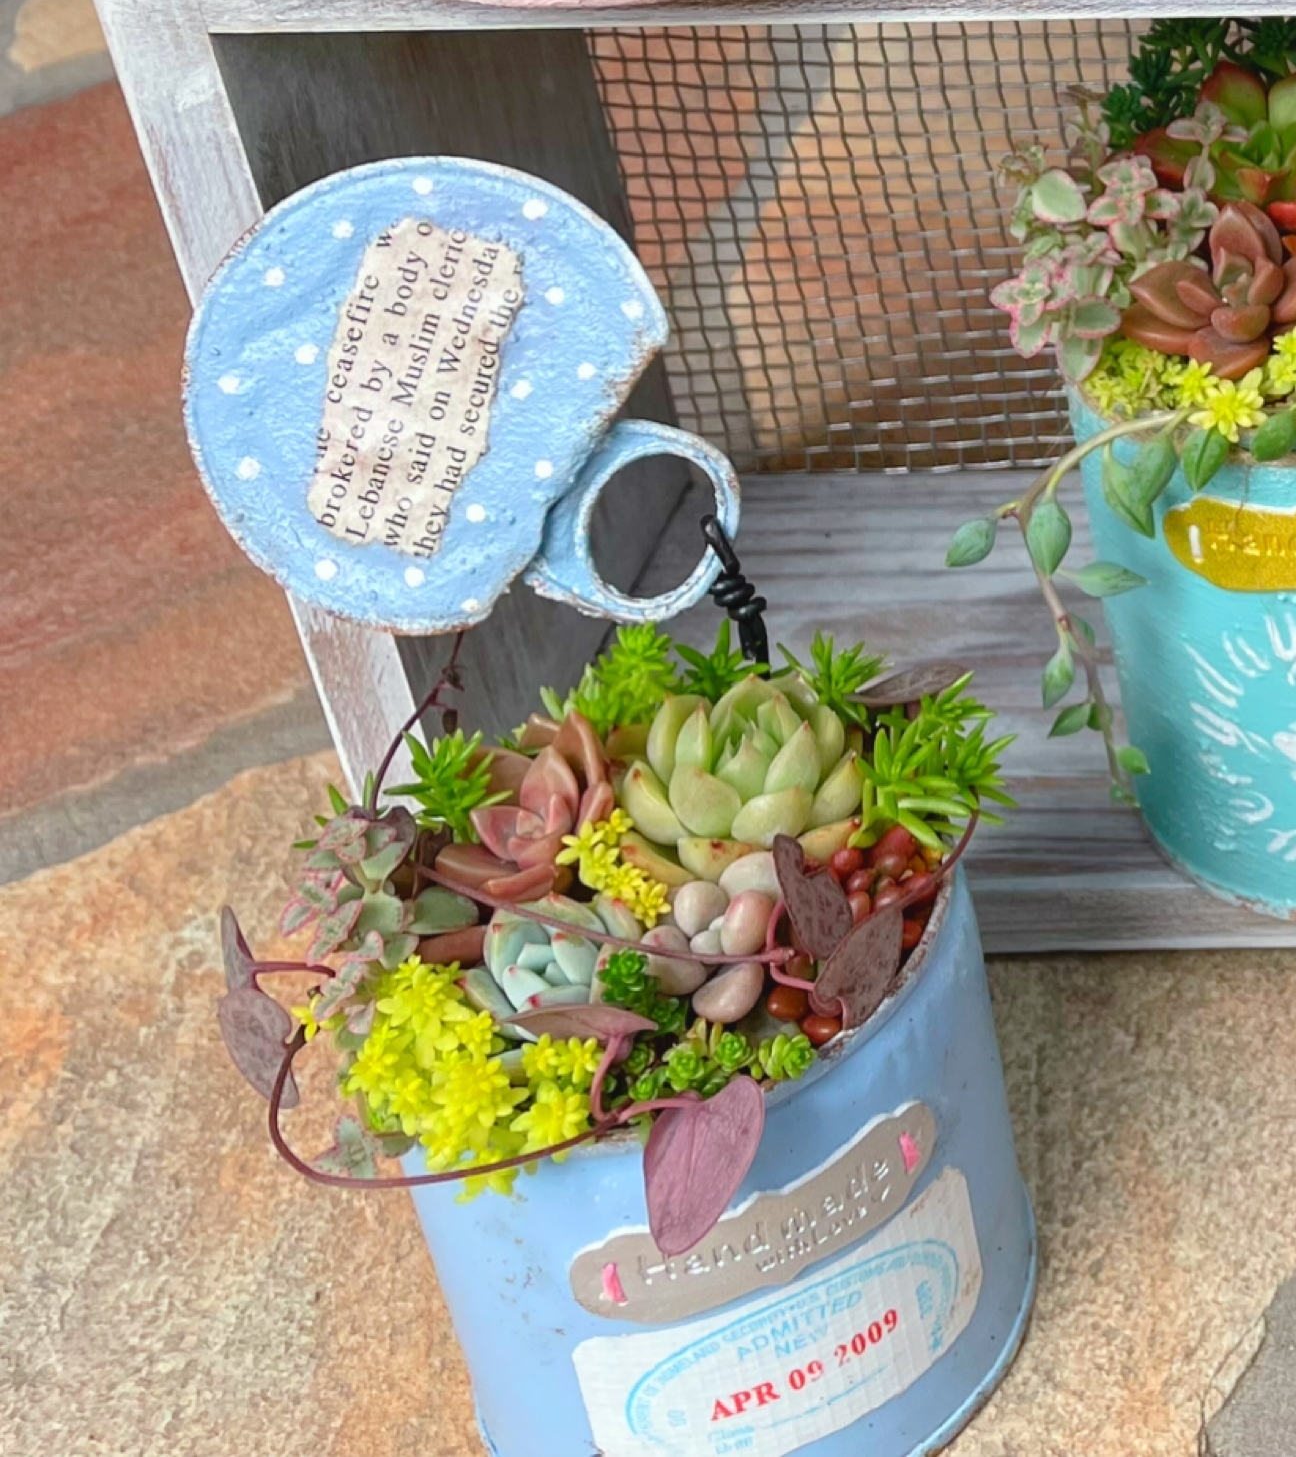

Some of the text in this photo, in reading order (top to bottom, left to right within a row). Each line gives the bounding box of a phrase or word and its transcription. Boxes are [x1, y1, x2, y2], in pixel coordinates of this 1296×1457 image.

[326, 274, 380, 404] ceasefire
[383, 332, 399, 347] a
[384, 250, 428, 317] body
[346, 419, 404, 540] Lebanese
[391, 313, 441, 407] Muslim
[360, 359, 394, 393] by
[435, 446, 467, 494] had
[459, 338, 500, 436] secured
[490, 288, 520, 329] the
[317, 407, 373, 529] brokered
[383, 495, 413, 547] who
[407, 432, 437, 484] said
[429, 389, 452, 421] on
[711, 1381, 781, 1422] APR
[788, 1357, 825, 1393] 09
[834, 1308, 898, 1367] 2009
[737, 1290, 863, 1362] ADMITTED
